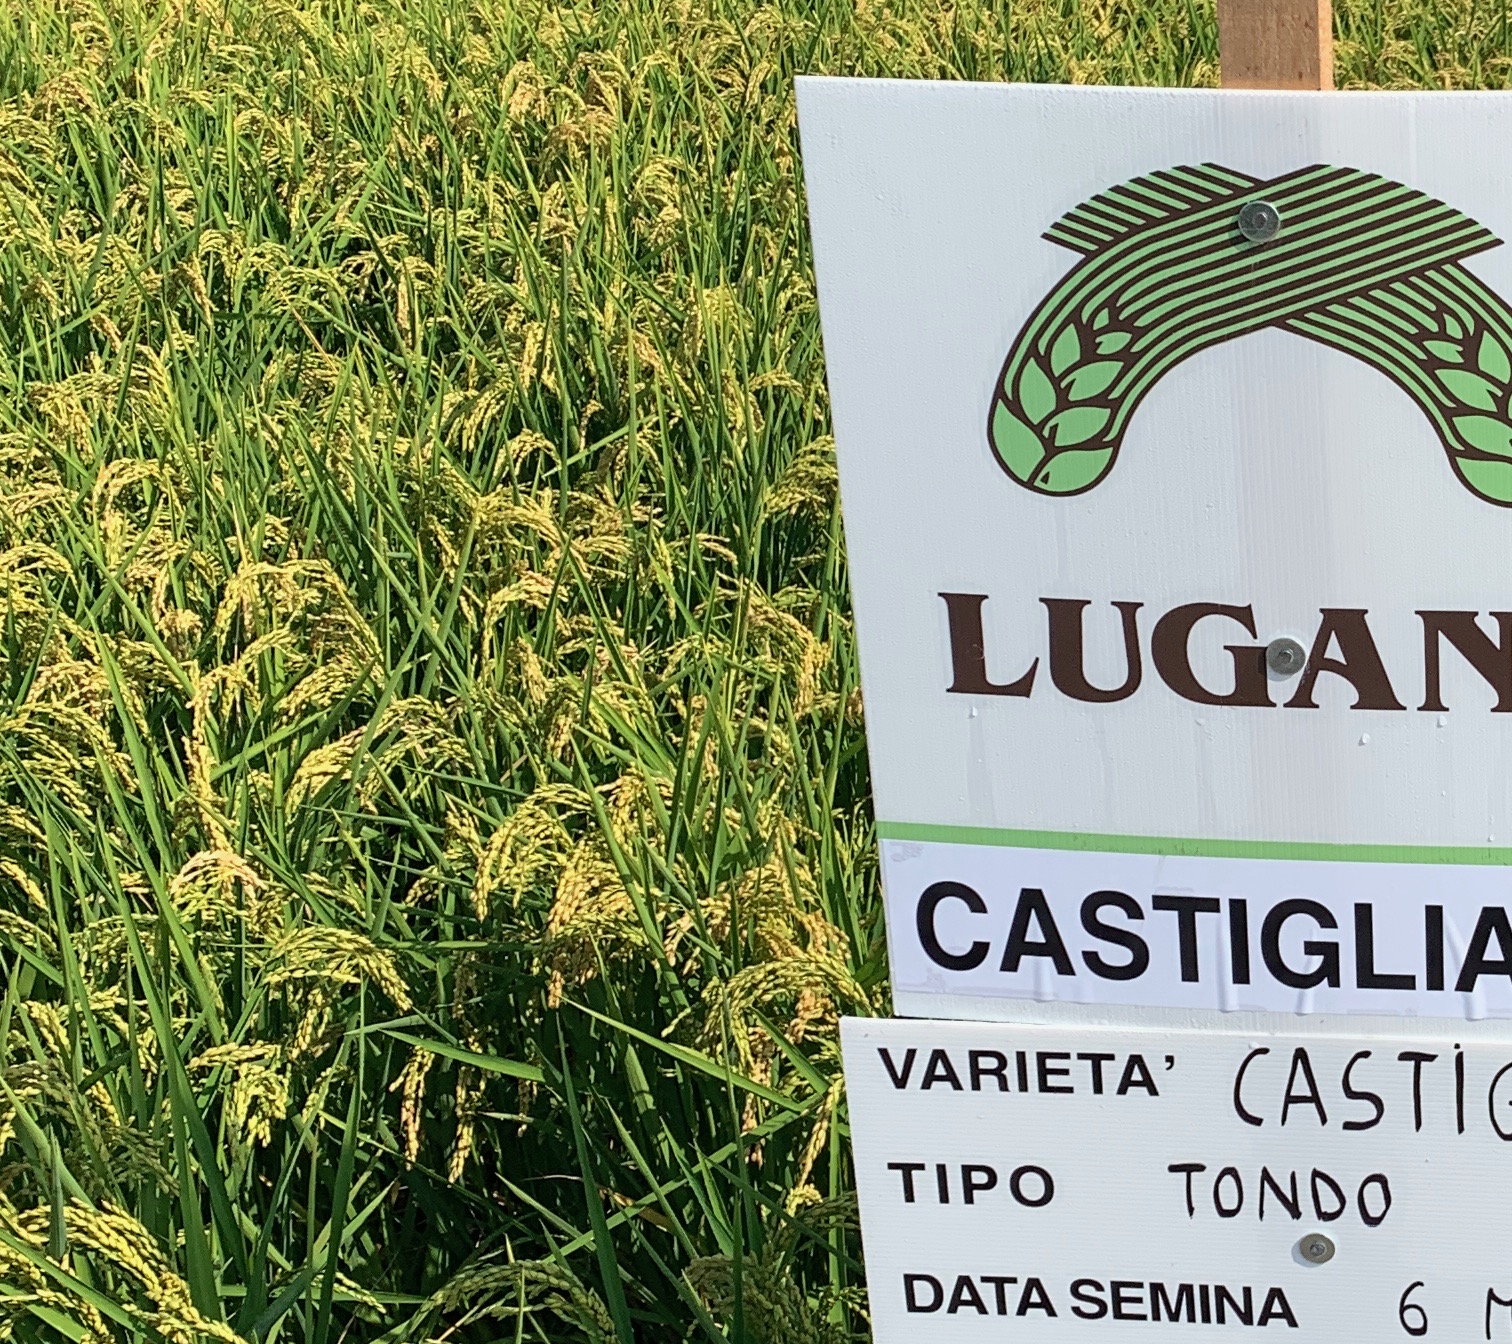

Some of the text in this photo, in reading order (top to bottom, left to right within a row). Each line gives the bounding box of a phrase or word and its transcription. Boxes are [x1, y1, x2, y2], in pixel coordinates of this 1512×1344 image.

[877, 1047, 1176, 1097] VARIETA'
[887, 1162, 1392, 1228] TIPO TONDO
[903, 1273, 1058, 1318] DATA
[1069, 1278, 1299, 1328] SEMINA
[1398, 1280, 1428, 1337] 6
